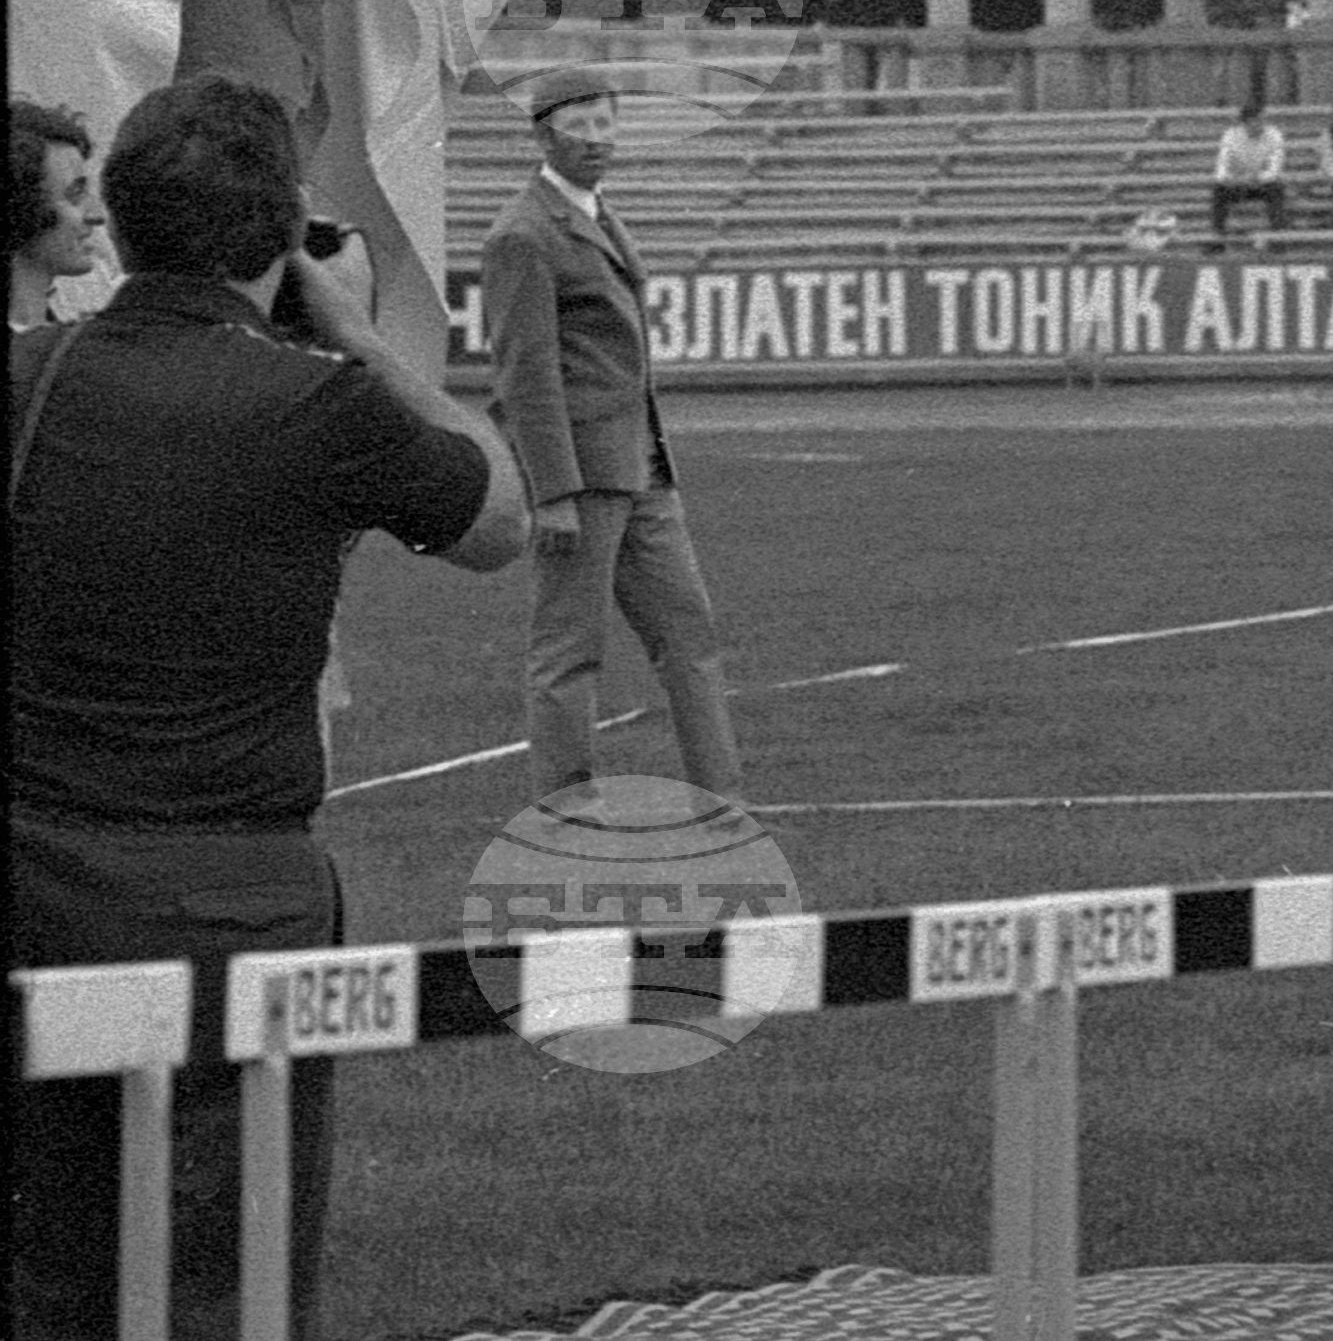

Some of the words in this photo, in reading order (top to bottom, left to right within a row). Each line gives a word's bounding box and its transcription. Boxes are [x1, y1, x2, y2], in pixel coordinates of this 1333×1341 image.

[645, 269, 907, 358] ЗЛАТЕН
[925, 266, 1163, 354] ТОНИК
[926, 915, 1009, 982] BERG
[1073, 902, 1157, 968] BERG
[296, 961, 397, 1035] BERG
